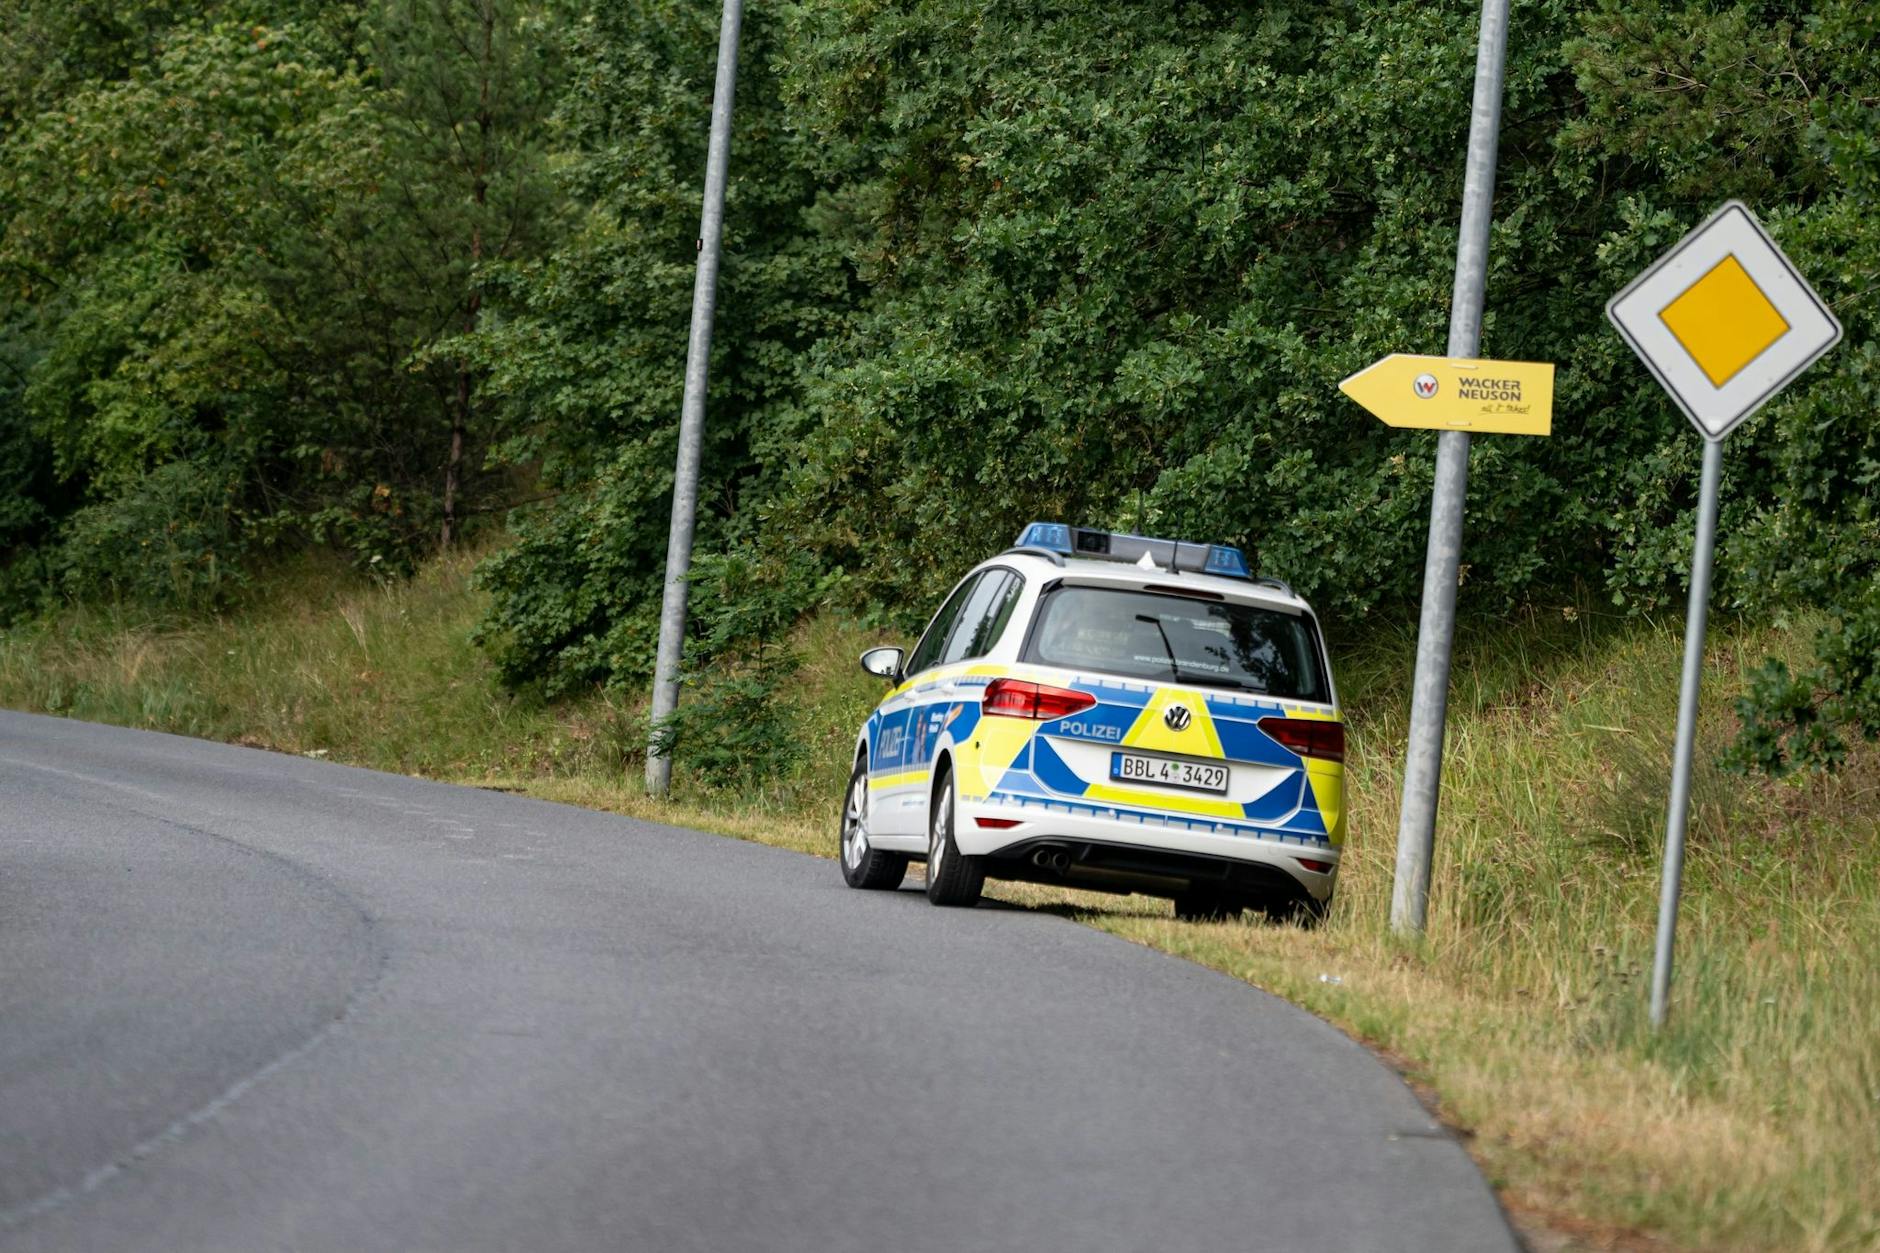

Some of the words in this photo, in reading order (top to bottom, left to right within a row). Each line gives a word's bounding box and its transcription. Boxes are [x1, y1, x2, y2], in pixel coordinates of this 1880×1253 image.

[1458, 377, 1521, 391] WACKER
[1458, 389, 1521, 402] NEUSON
[1060, 720, 1121, 740] POLIZEI
[1123, 758, 1155, 778] BBL
[1160, 763, 1169, 780] 4
[1182, 765, 1224, 787] 3429
